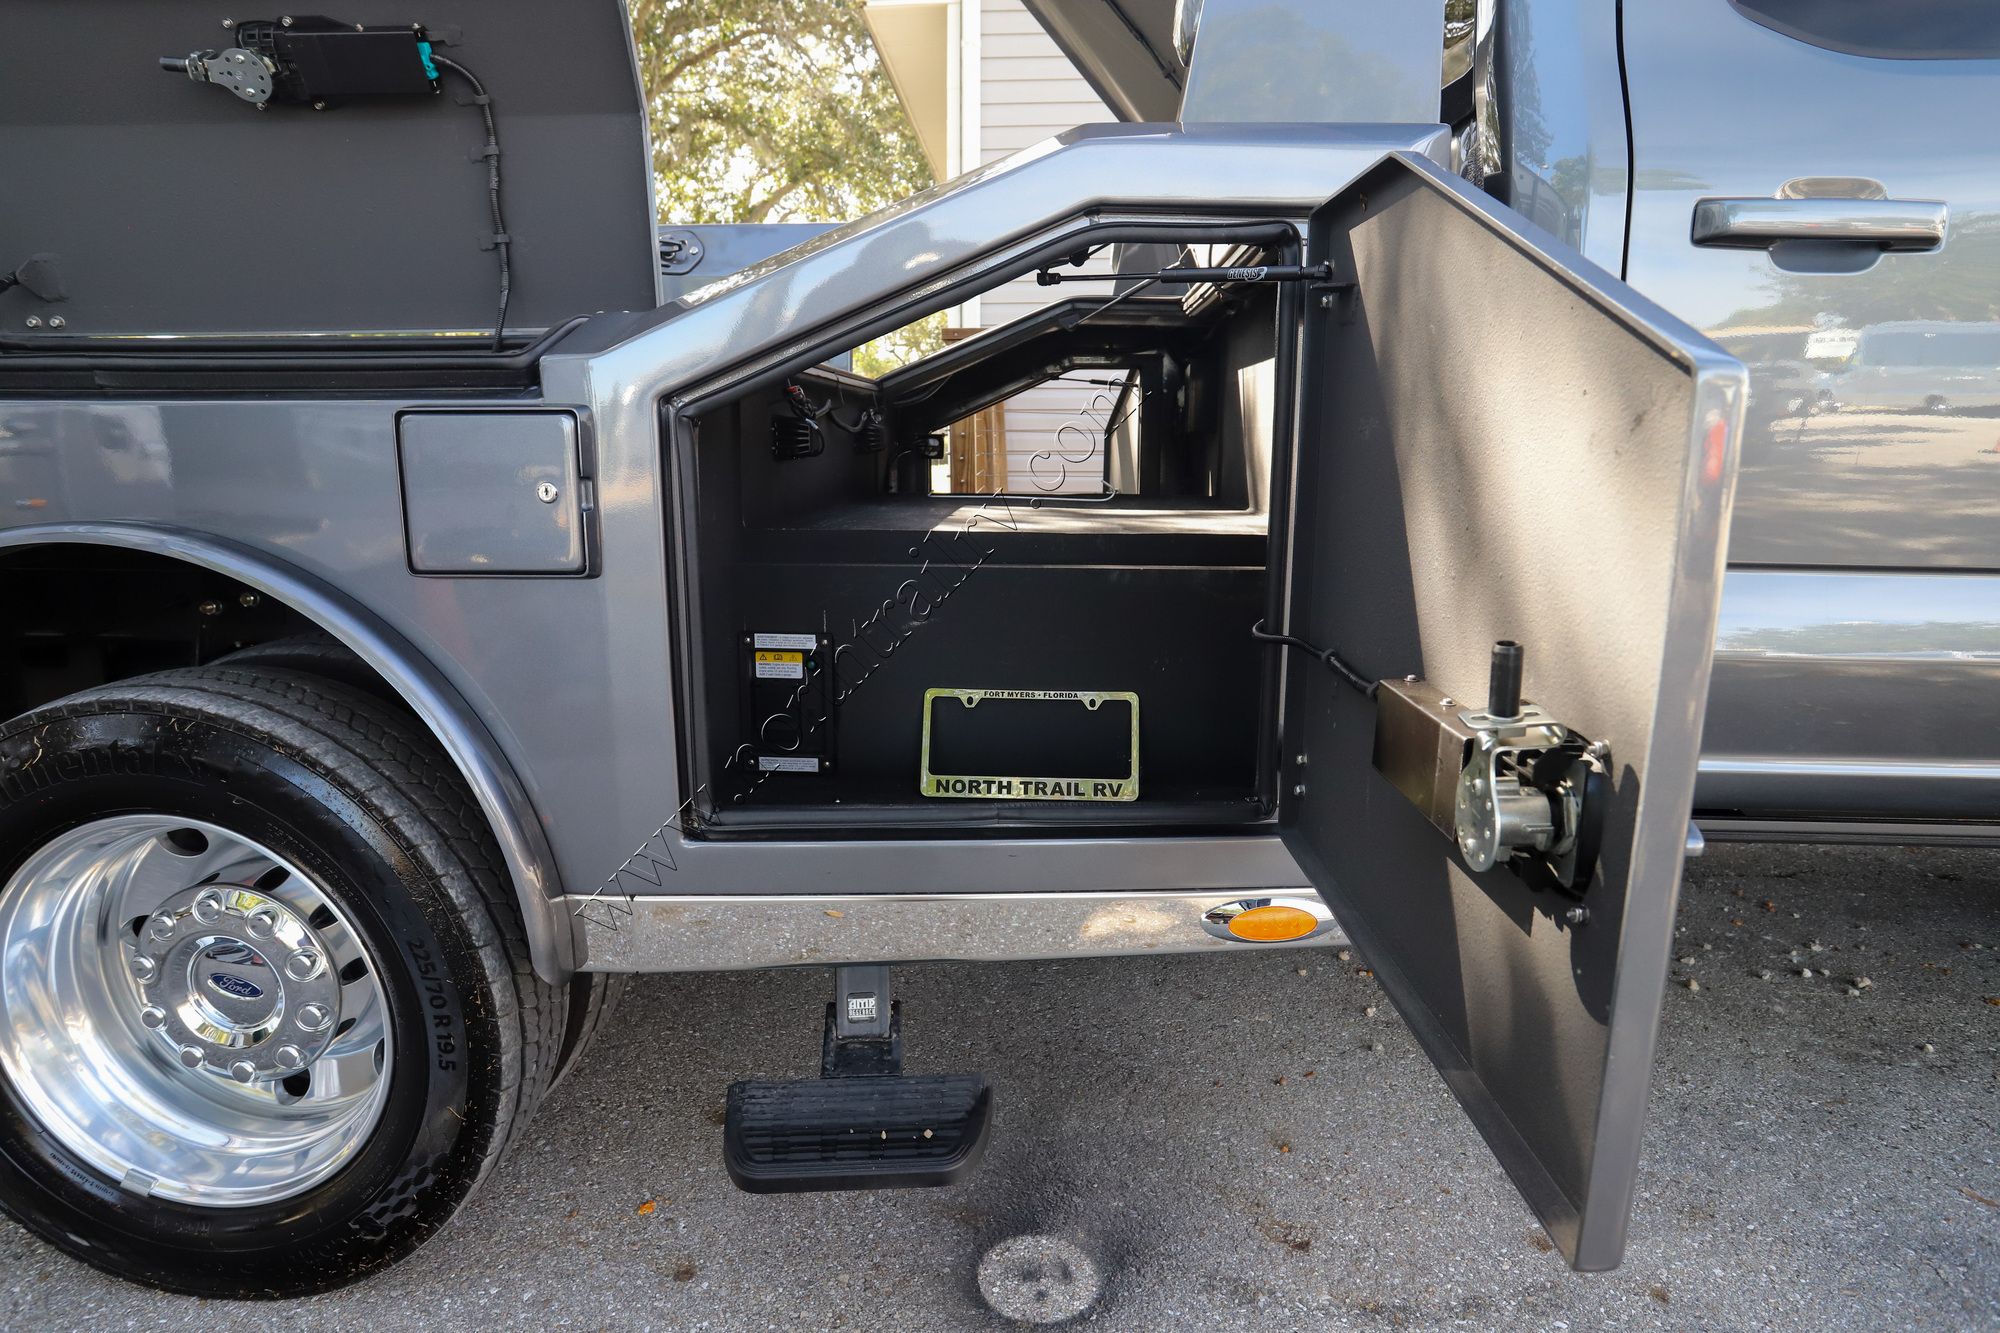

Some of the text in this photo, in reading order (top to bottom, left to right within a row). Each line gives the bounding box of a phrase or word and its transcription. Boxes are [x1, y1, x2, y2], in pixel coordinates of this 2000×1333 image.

[1227, 268, 1261, 280] GENESIS
[983, 690, 1006, 698] FORT
[1007, 690, 1036, 698] MYERS
[935, 779, 1124, 798] NORTH TRAIL RV
[219, 976, 253, 995] Ford
[406, 937, 457, 1072] 225/70 R 19.5
[848, 998, 876, 1009] AMP
